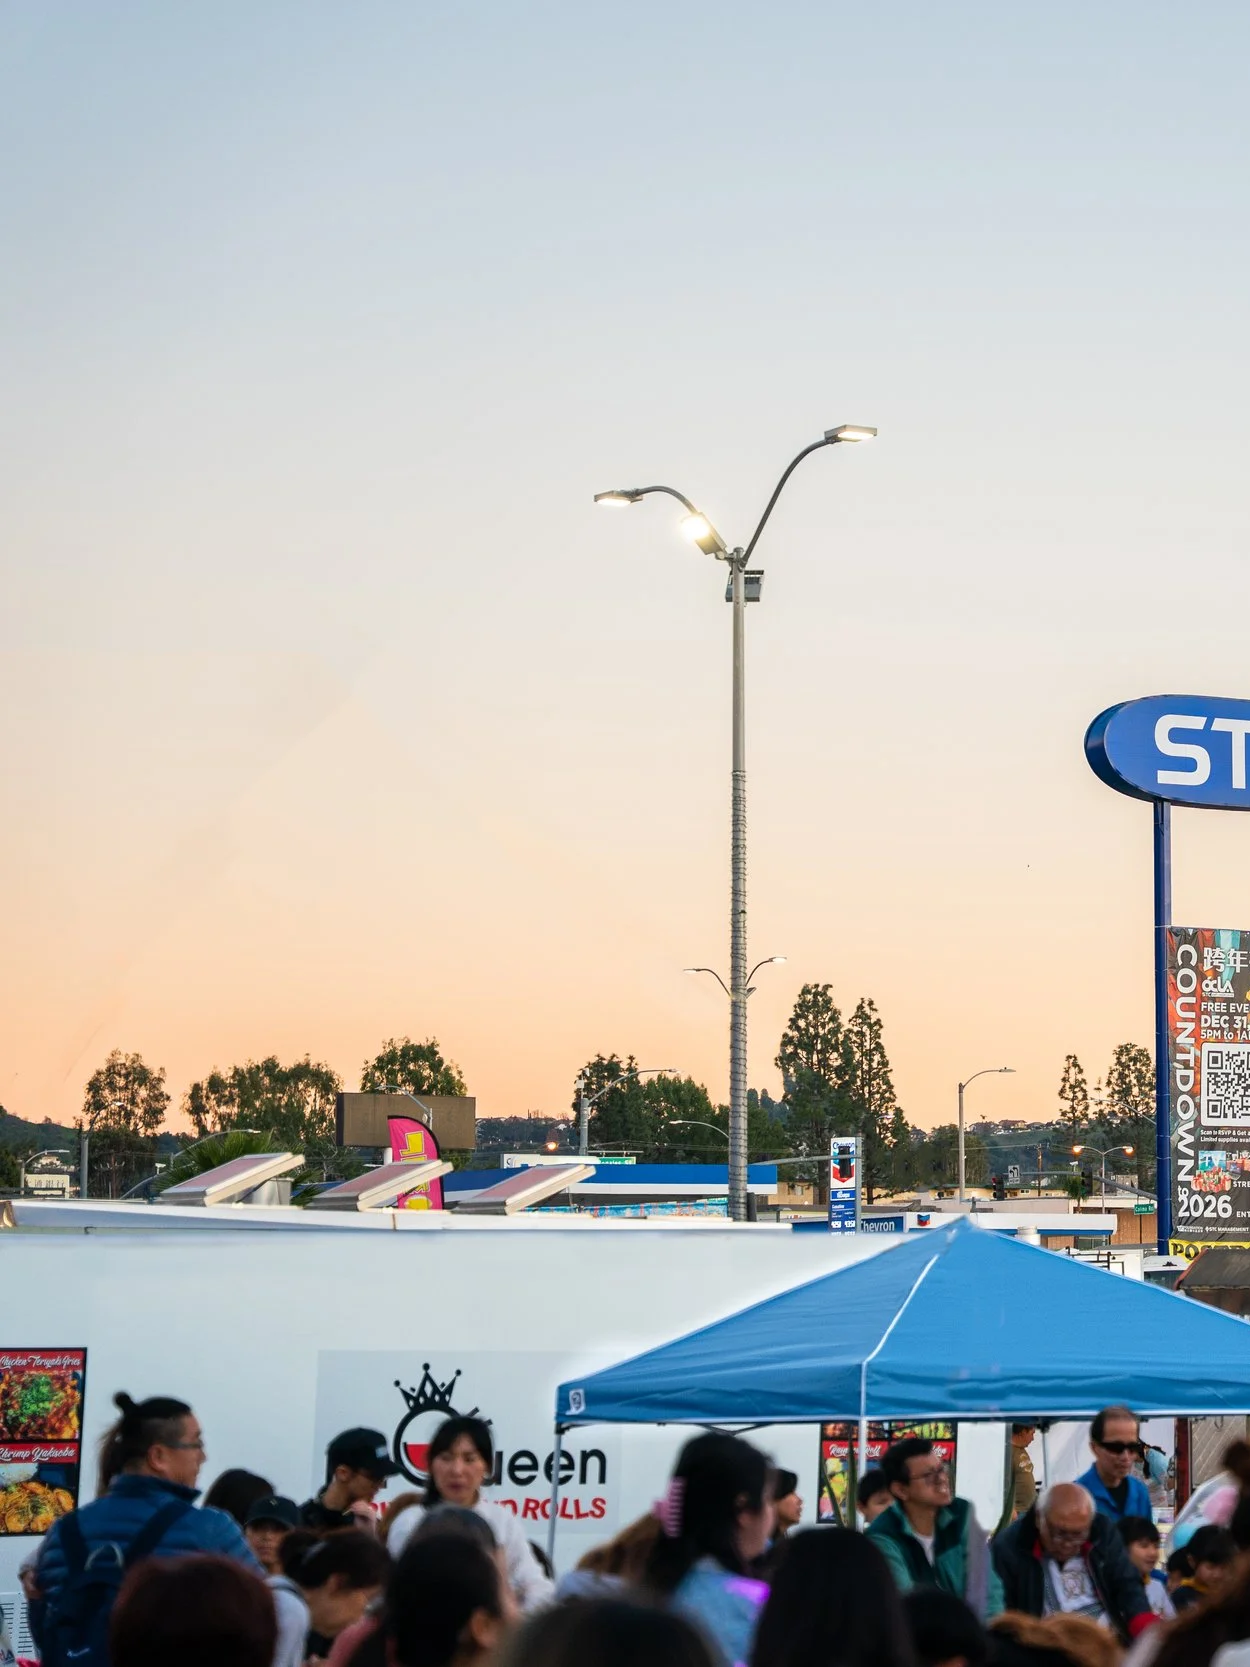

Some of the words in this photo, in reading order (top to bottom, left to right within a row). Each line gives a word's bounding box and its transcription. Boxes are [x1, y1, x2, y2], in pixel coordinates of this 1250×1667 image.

[1201, 1002, 1227, 1012] FREE
[1200, 1014, 1230, 1028] DEC
[1200, 1029, 1221, 1040] 5PM
[1223, 1030, 1234, 1040] to
[1175, 943, 1198, 1182] COUNTDOWN
[1177, 1185, 1190, 1198] to
[1177, 1194, 1233, 1219] 2026
[32, 1446, 76, 1462] Yakisoba
[521, 1497, 608, 1521] ROLLS
